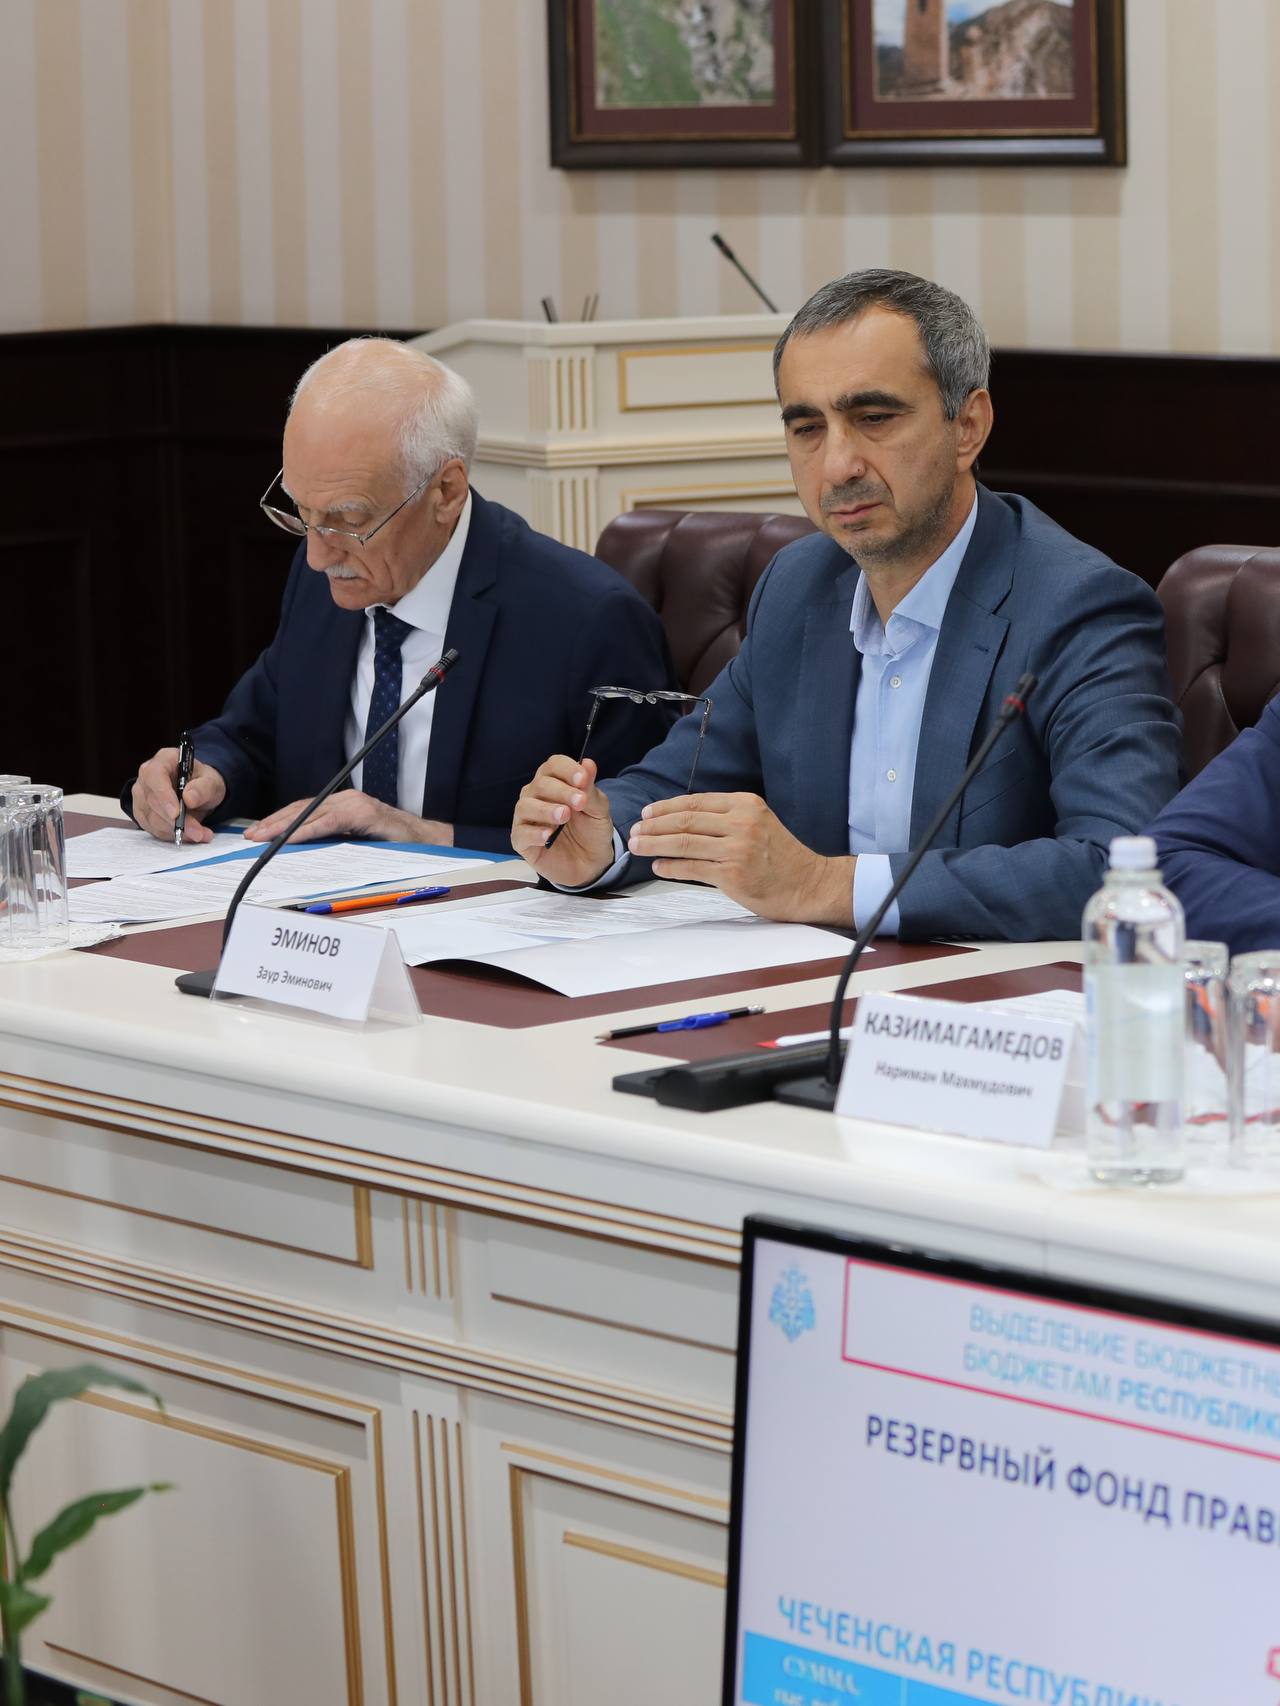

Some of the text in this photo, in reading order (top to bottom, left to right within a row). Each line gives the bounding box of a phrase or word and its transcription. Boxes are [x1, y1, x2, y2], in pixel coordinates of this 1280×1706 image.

[271, 927, 341, 957] ЭМИНОВ
[256, 965, 333, 993] Заур Эминович
[864, 1011, 1065, 1062] КАЗИМАГАМЕДОВ
[874, 1060, 937, 1084] Нариман
[969, 1304, 1127, 1364] ВЫДЕЛЕНИЕ
[962, 1343, 1111, 1398] БЮДЖЕТАМ
[866, 1414, 1055, 1491] РЕЗЕРВНЫЙ
[1066, 1464, 1171, 1529] ФОНД
[777, 1595, 1180, 1706] ЧЕЧЕНСКАЯ РЕСПУБЛ
